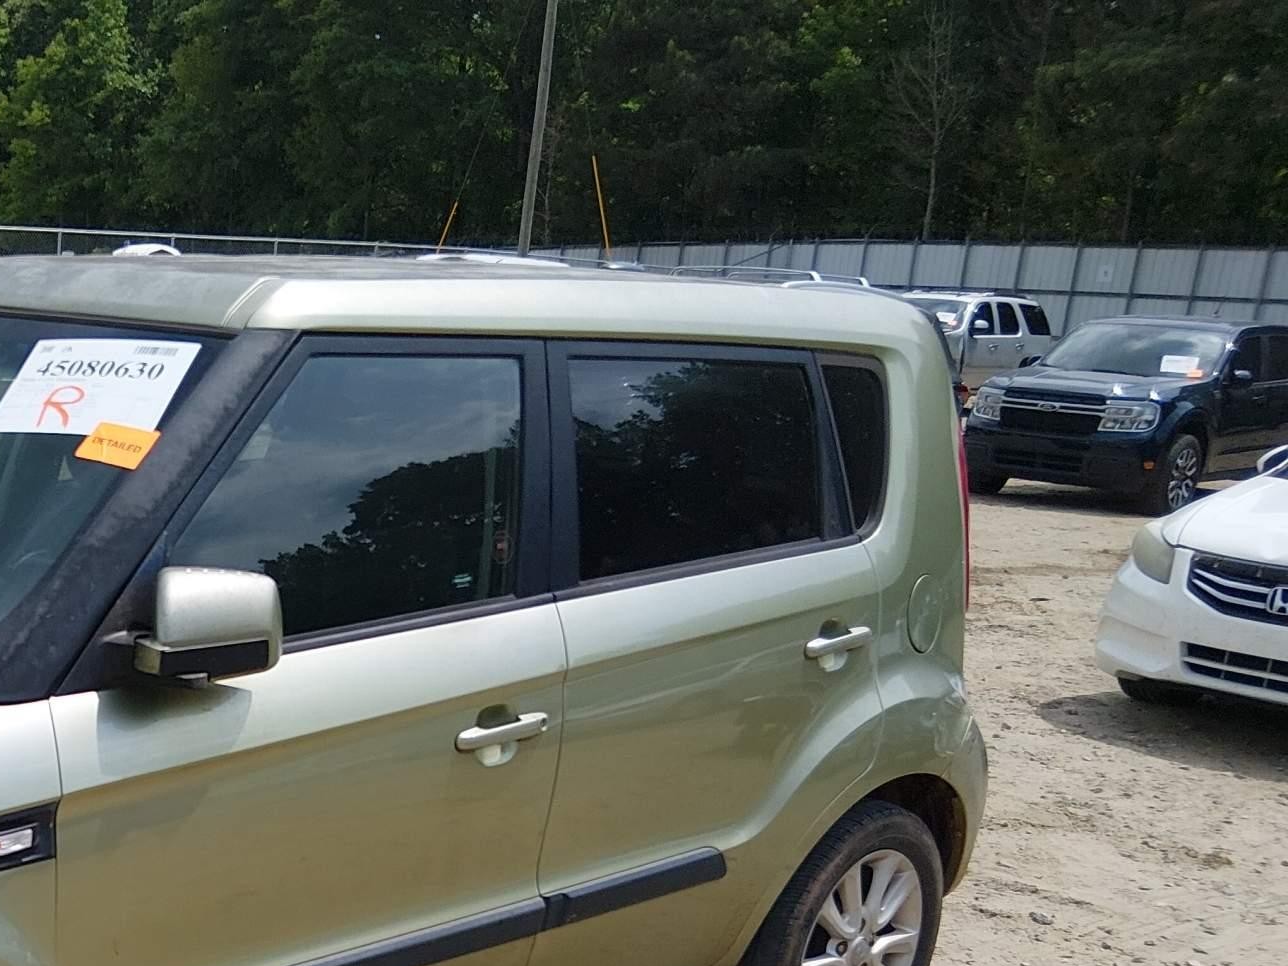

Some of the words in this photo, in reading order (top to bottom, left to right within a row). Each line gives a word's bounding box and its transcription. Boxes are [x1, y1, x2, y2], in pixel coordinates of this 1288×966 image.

[36, 359, 165, 381] 45080630
[35, 385, 86, 429] R
[91, 436, 143, 454] DETAILED
